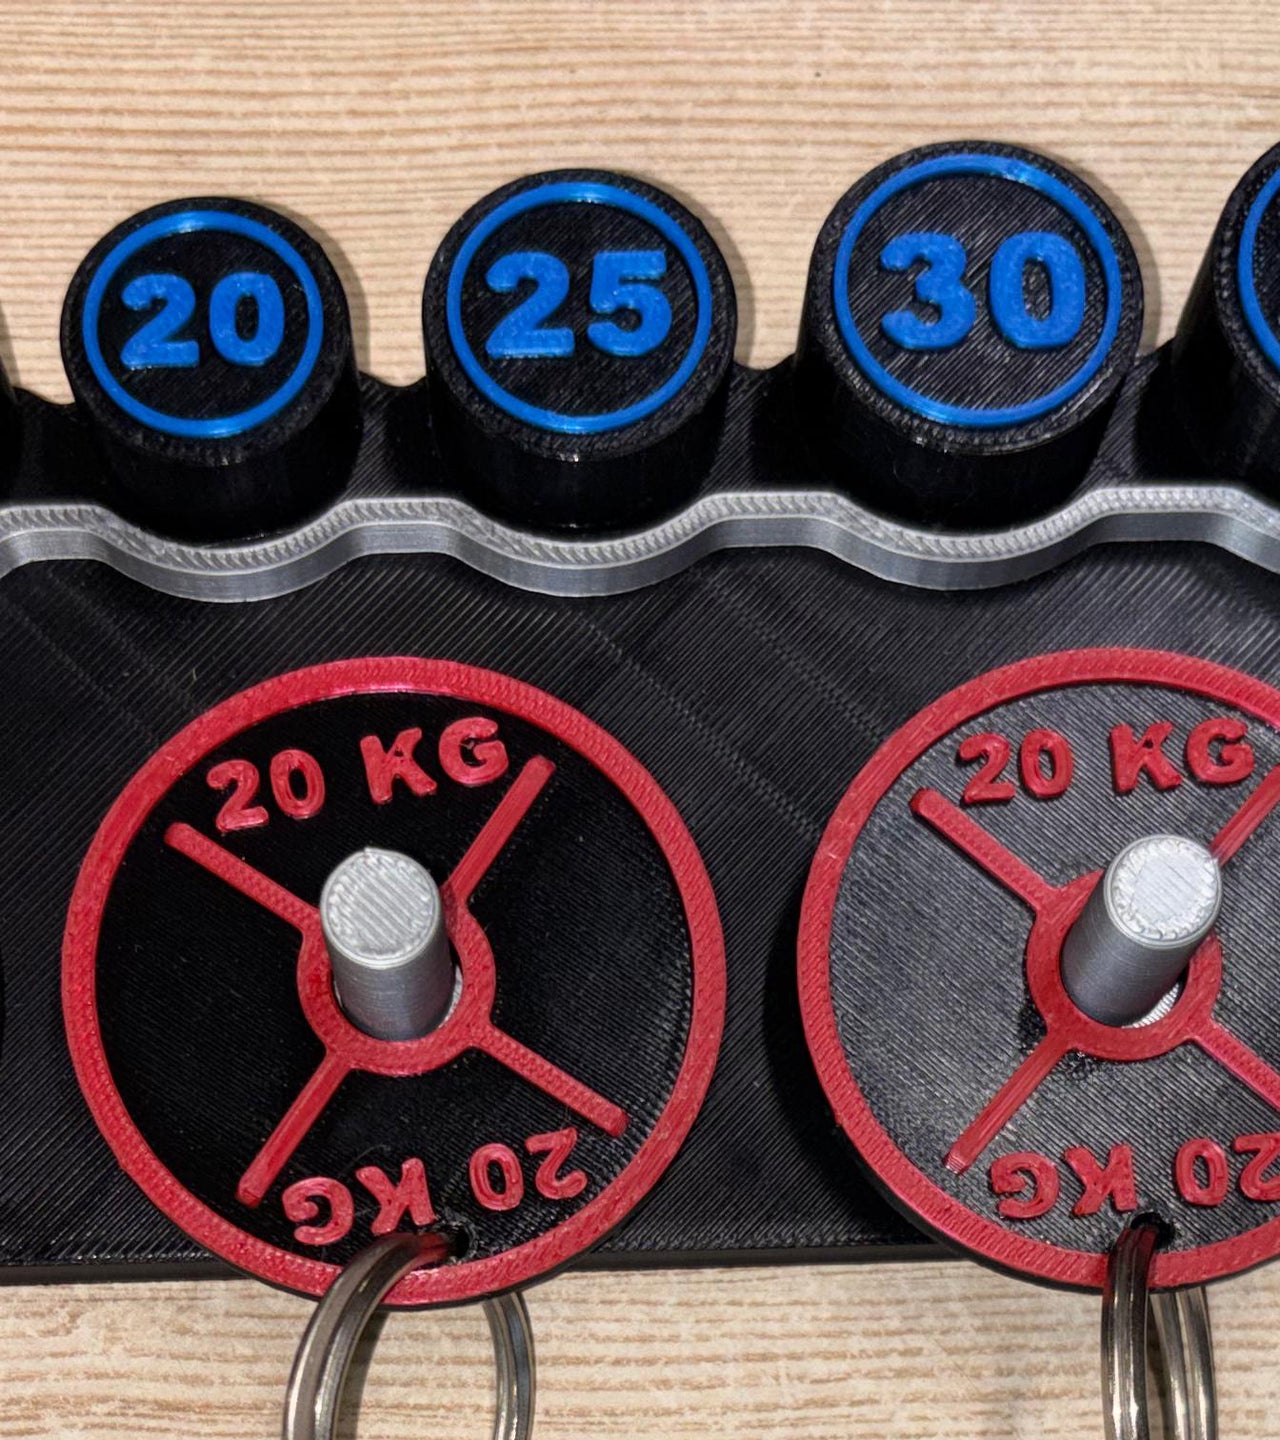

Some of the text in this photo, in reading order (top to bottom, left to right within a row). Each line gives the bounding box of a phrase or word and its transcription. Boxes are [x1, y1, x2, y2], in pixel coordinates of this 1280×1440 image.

[119, 270, 285, 371] 20
[484, 248, 673, 360] 25
[879, 229, 1088, 350] 30
[205, 715, 510, 835] 20 KG
[957, 715, 1257, 804] 20 KG
[281, 1126, 588, 1247] 20 KG
[989, 1142, 1140, 1219] KG
